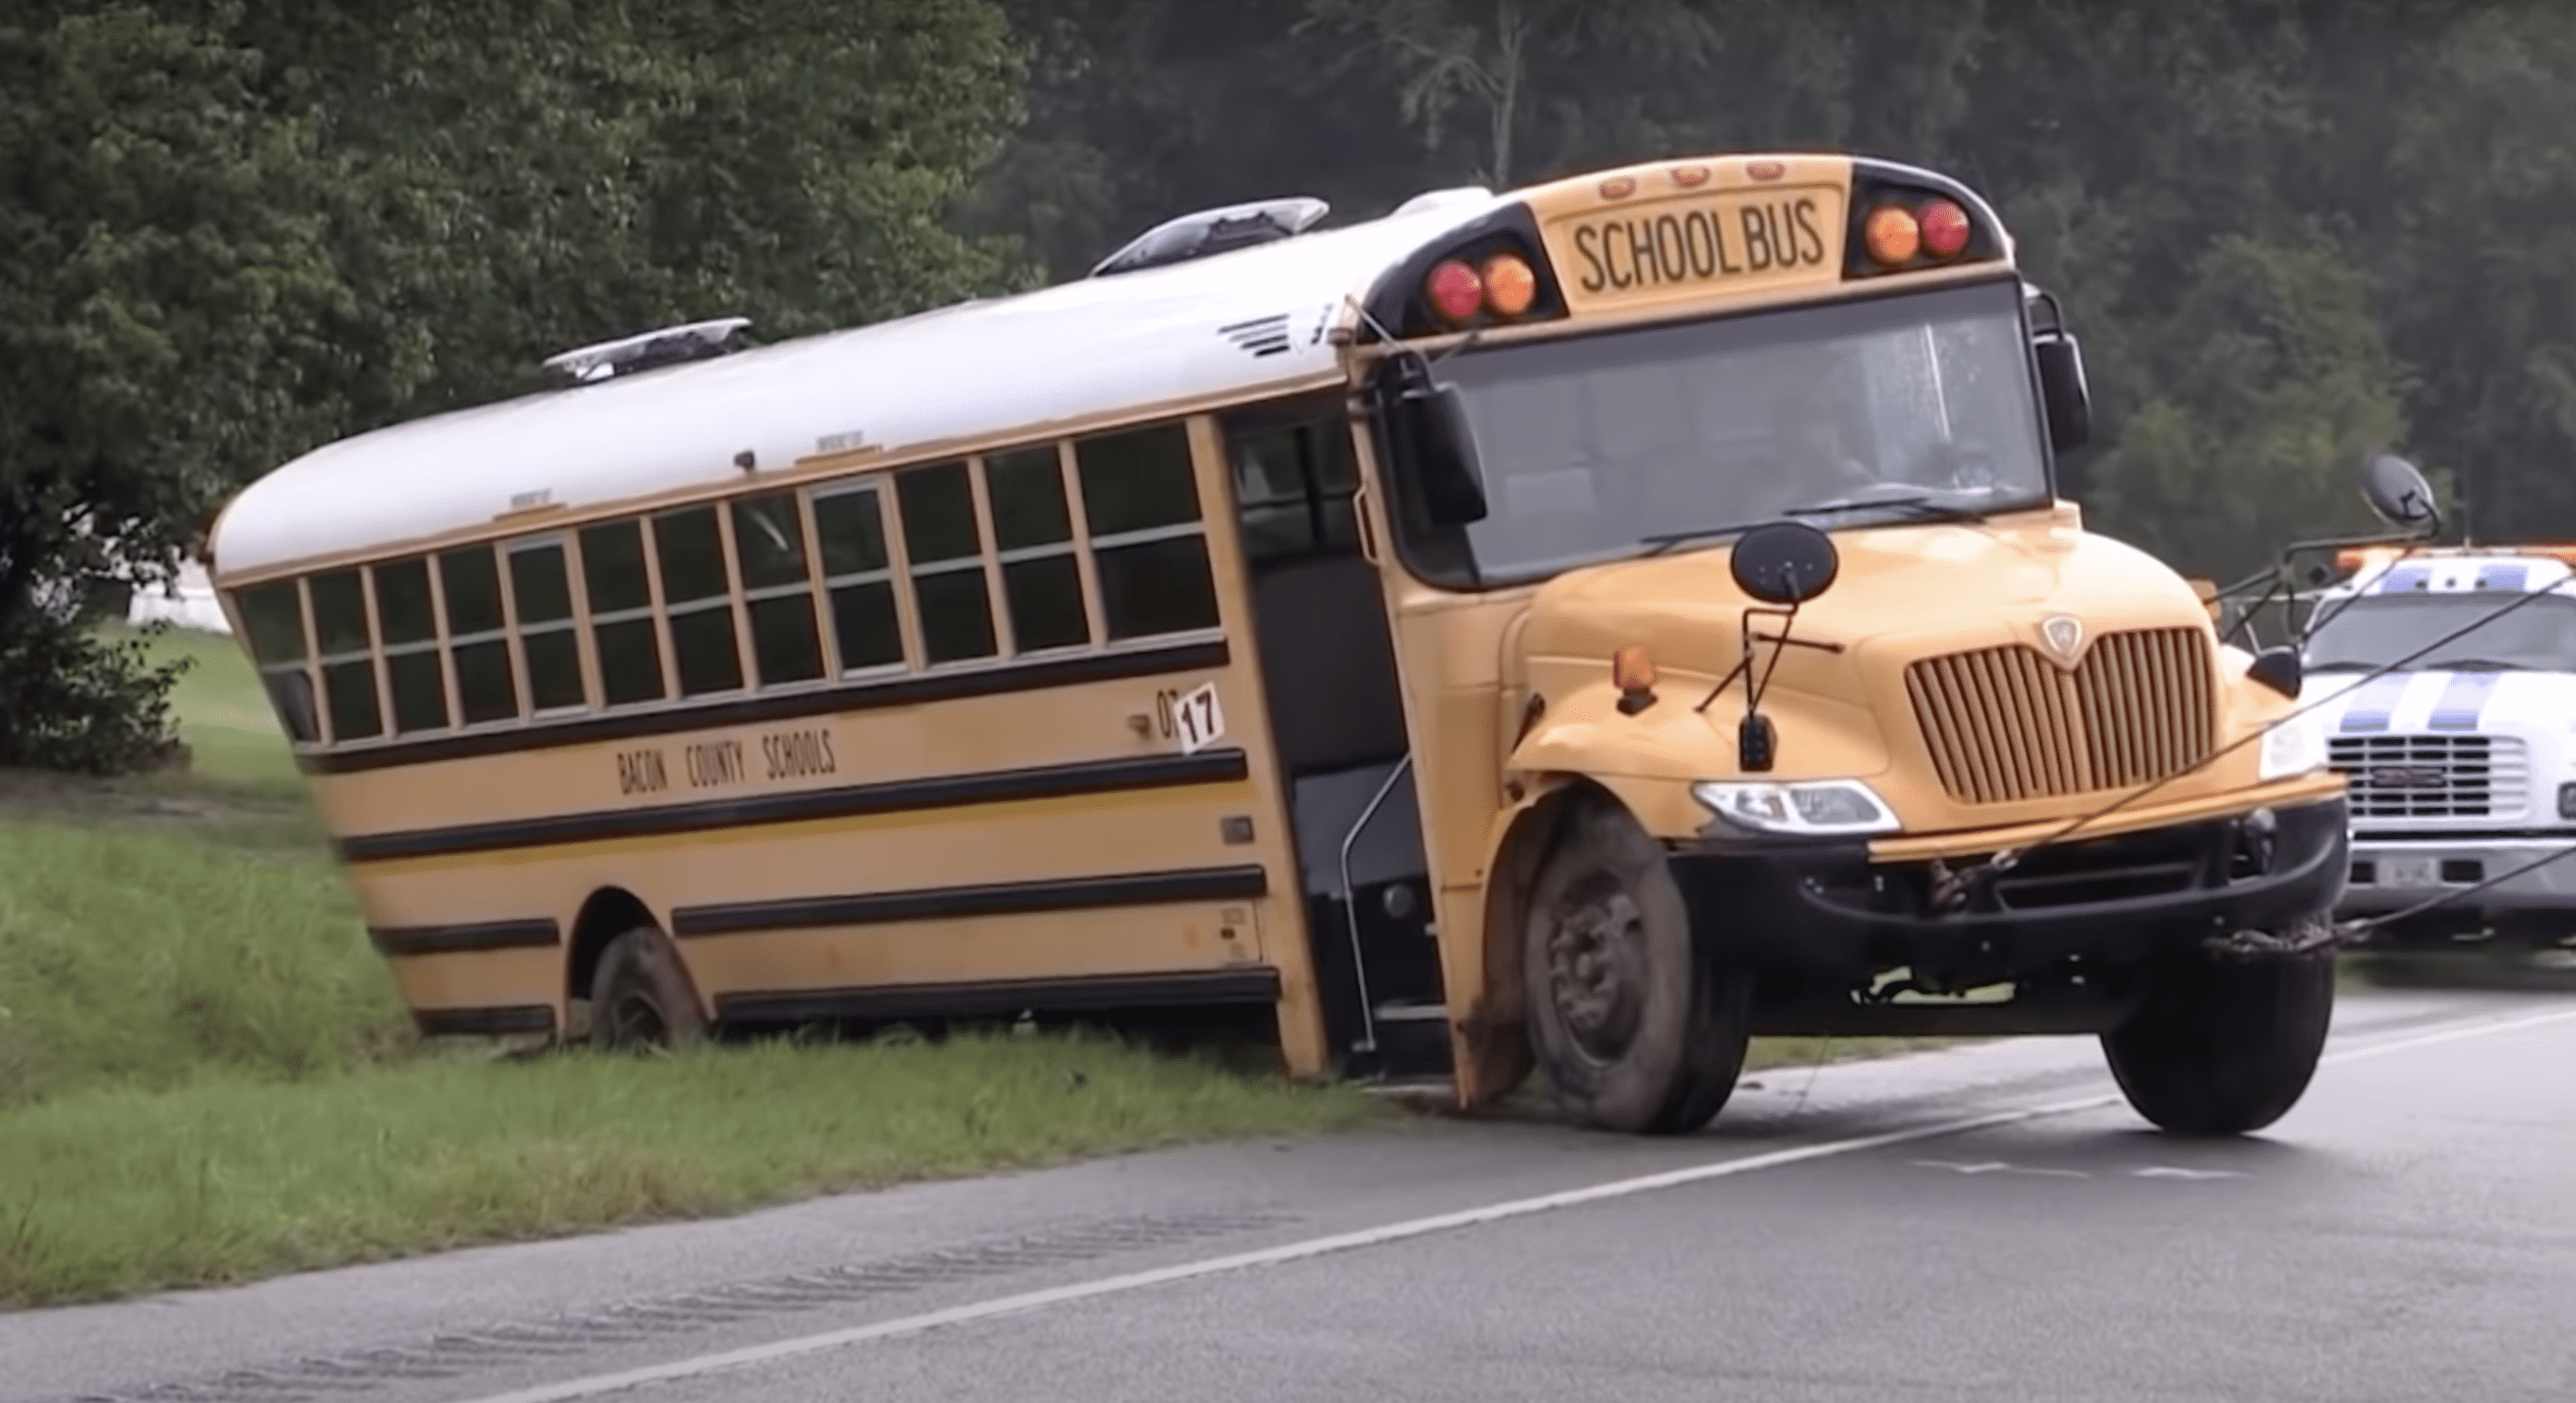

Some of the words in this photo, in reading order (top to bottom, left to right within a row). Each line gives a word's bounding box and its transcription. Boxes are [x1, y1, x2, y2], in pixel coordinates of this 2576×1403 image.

[1573, 210, 1741, 292] SCHOOL
[1741, 198, 1823, 271] BUS
[1181, 690, 1214, 743] 17
[617, 750, 669, 795] BACON
[685, 739, 745, 788] COUNTY
[762, 728, 837, 780] SCHOOLS
